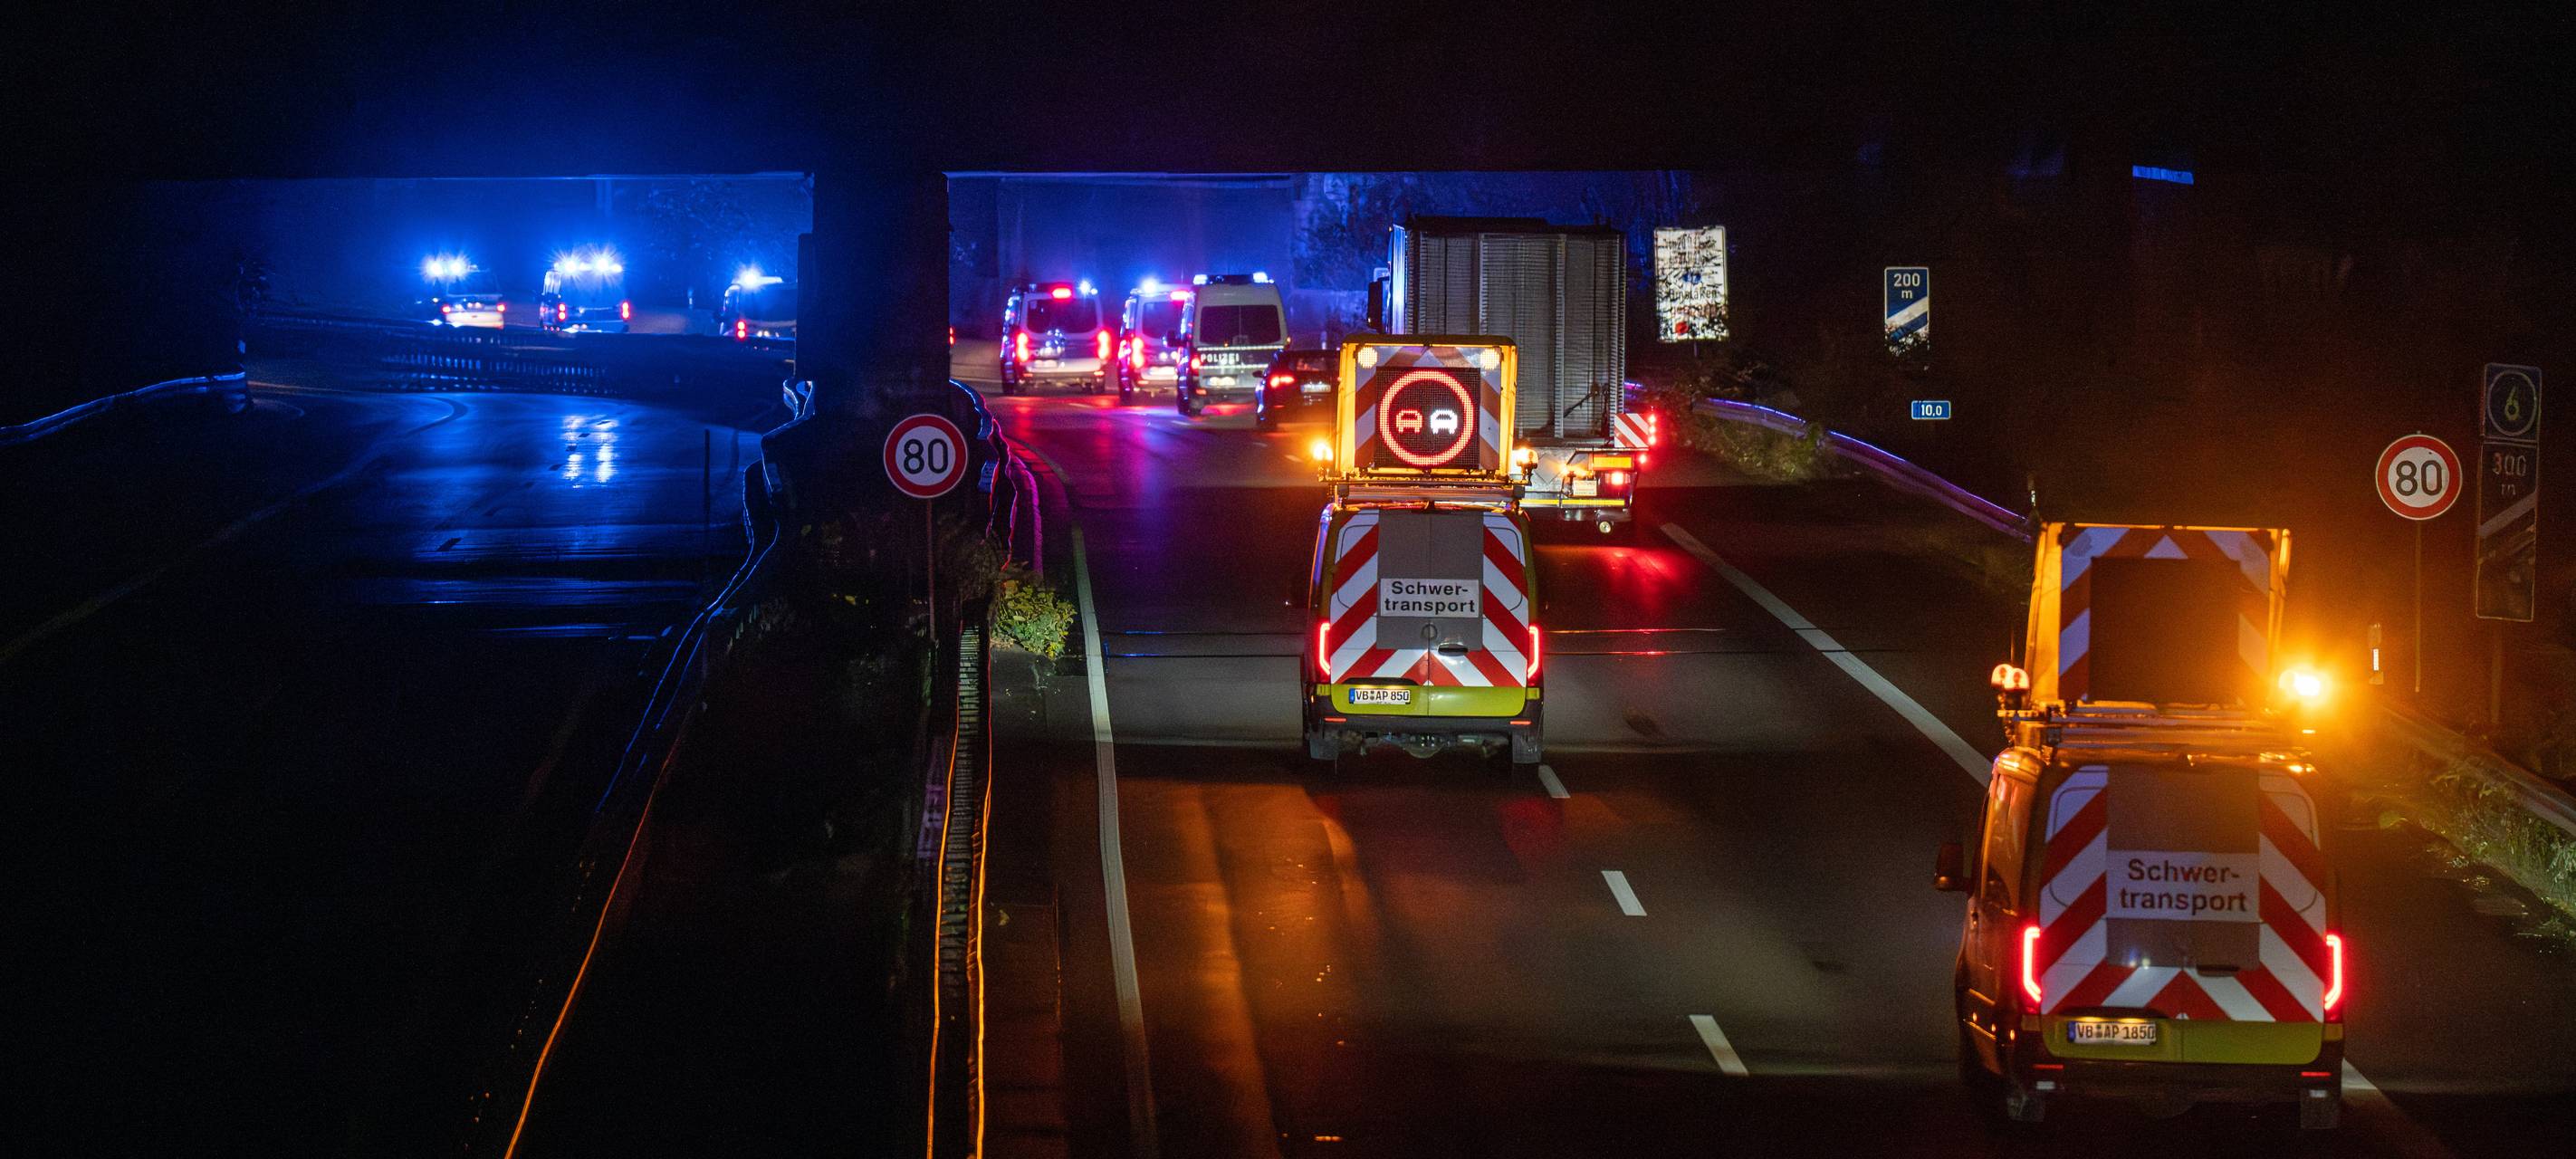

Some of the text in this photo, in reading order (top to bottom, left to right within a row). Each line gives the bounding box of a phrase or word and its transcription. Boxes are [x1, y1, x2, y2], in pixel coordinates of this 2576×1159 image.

[1893, 273, 1920, 287] 200
[1901, 290, 1913, 299] m
[1200, 353, 1240, 364] POLIZEI
[903, 438, 949, 474] 80
[2492, 452, 2527, 476] 300
[2395, 460, 2443, 496] 80
[2500, 483, 2516, 496] m
[1391, 580, 1469, 596] Schwer-
[1384, 598, 1476, 615] transport
[1355, 690, 1410, 701] VB AP 850
[2128, 858, 2240, 884] Schwer-
[2119, 887, 2246, 915] transport
[2103, 1025, 2120, 1039] AP
[2121, 1025, 2155, 1039] 1850
